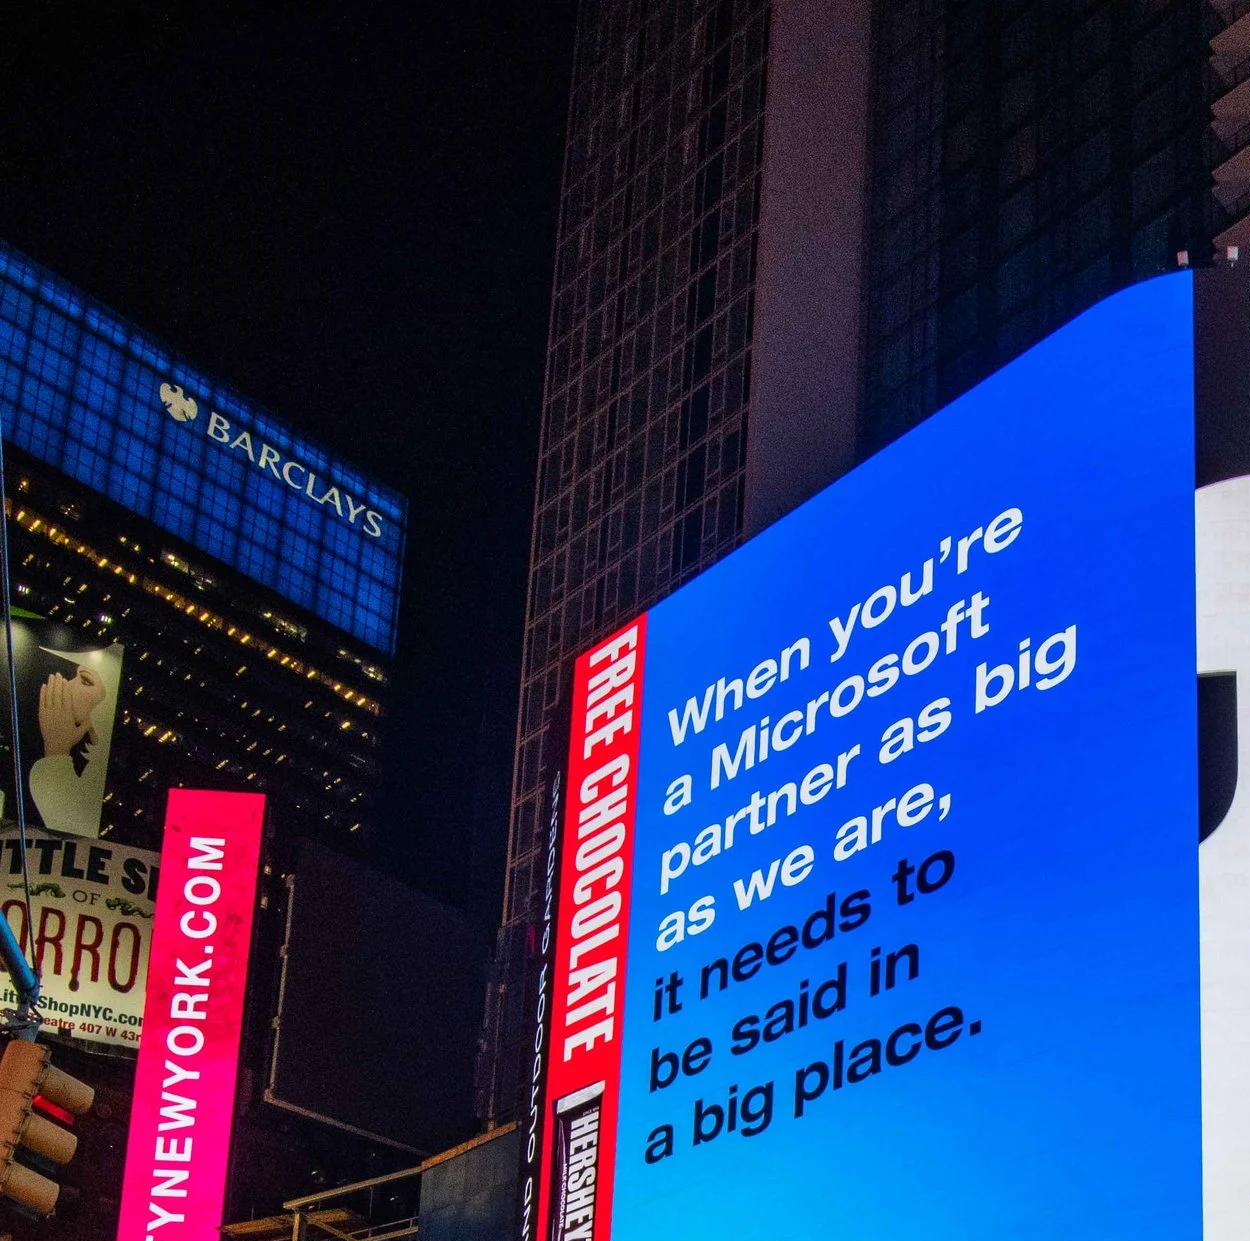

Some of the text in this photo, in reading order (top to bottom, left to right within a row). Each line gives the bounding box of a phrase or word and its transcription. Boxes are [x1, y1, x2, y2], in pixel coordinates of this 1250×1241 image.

[207, 411, 383, 538] BARCLAYS
[662, 593, 990, 817] a Microsoft
[667, 507, 1023, 748] When you're
[563, 624, 639, 1063] FREE CHOCOLATE
[660, 624, 1078, 895] partner as big
[0, 838, 112, 886] TTLE
[72, 889, 102, 906] OF
[652, 849, 957, 1022] it needs to
[655, 781, 955, 953] as we are,
[79, 1022, 103, 1034] 407
[105, 1026, 118, 1038] W
[527, 963, 548, 1164] OUTDOOR
[644, 1002, 984, 1165] a big place.
[648, 941, 921, 1093] be said in
